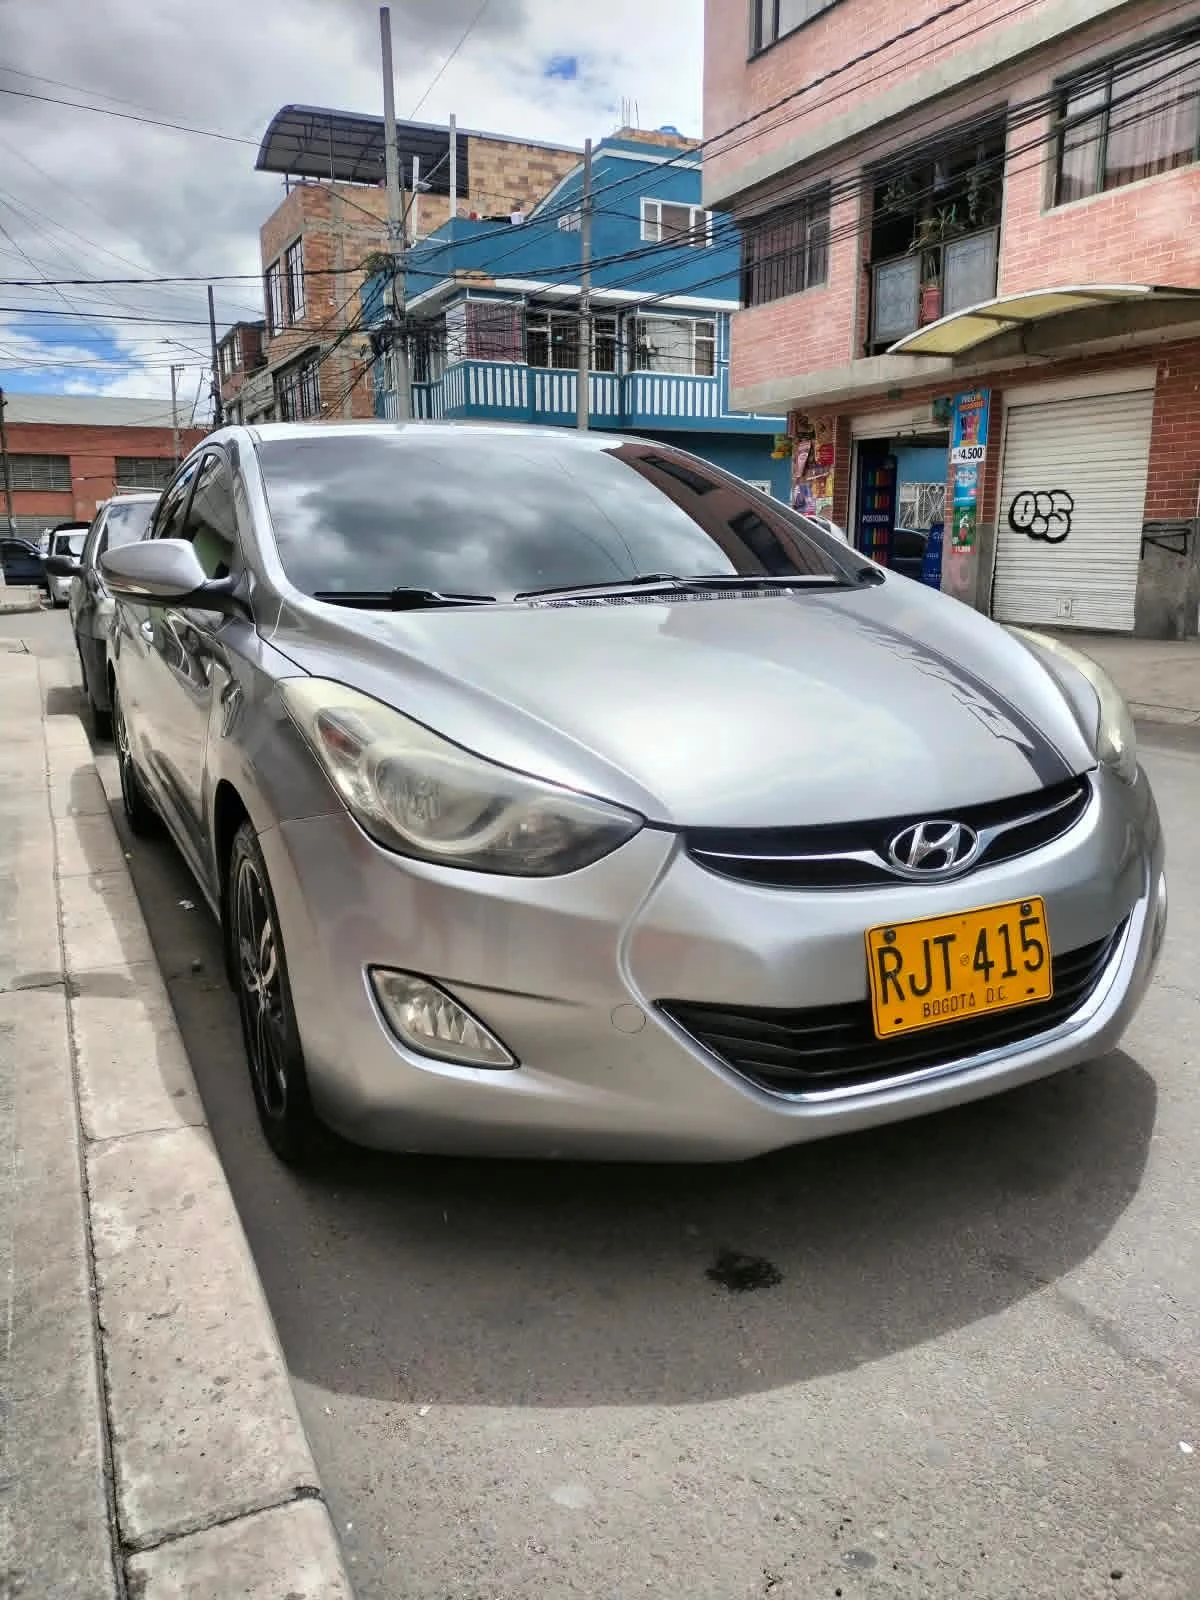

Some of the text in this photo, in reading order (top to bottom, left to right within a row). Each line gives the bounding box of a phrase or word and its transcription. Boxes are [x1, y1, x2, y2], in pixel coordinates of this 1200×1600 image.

[877, 917, 1044, 1005] RJT 415
[923, 993, 976, 1018] BOGOTA
